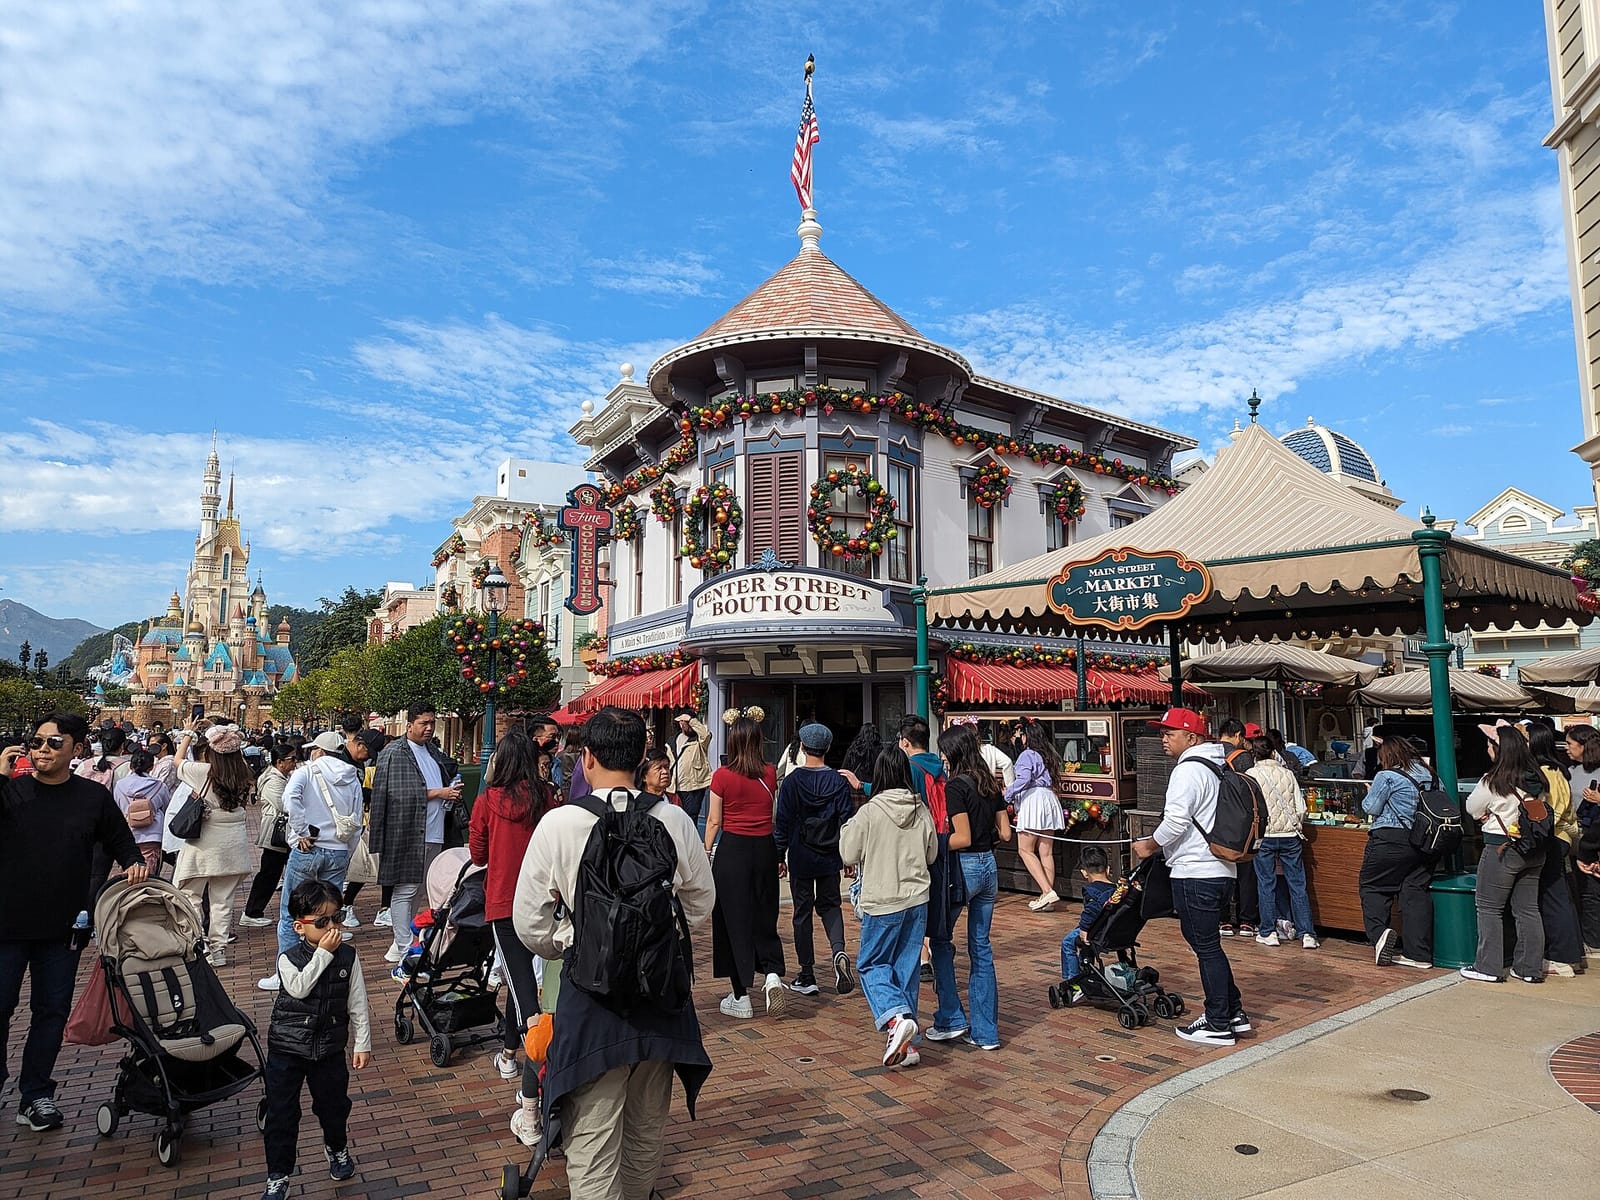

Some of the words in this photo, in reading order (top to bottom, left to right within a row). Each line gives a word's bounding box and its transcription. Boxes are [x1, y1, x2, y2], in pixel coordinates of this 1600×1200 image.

[569, 511, 607, 525] Fine
[580, 524, 593, 607] COLLECTIBLES
[1088, 567, 1115, 577] MAIN
[1117, 563, 1156, 575] STREET
[696, 577, 766, 608] CENTER
[774, 576, 872, 601] STREET
[1084, 574, 1163, 594] MARKET
[712, 595, 841, 616] BOUTIQUE
[1092, 592, 1160, 613] 大街市集
